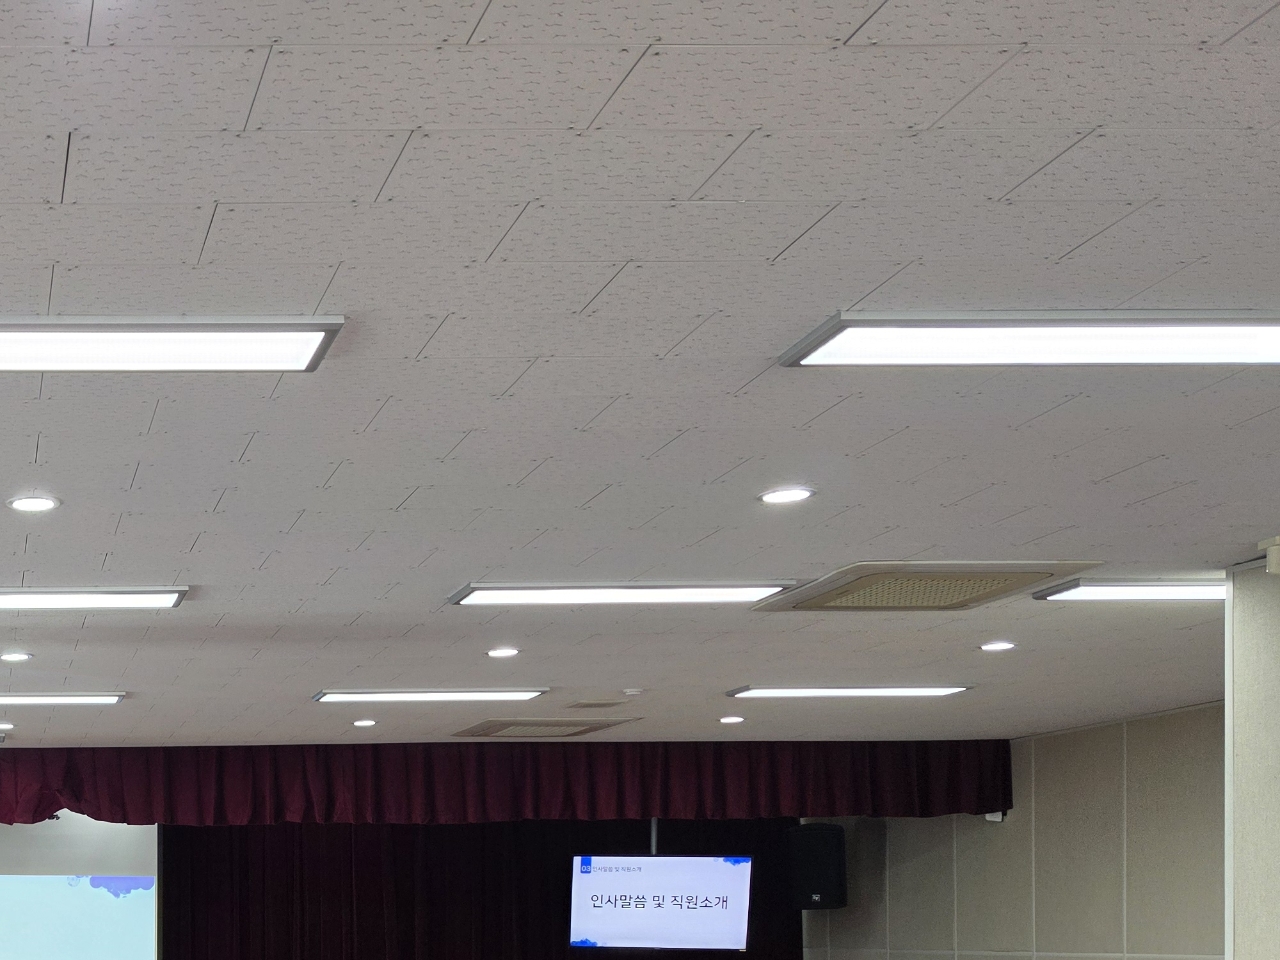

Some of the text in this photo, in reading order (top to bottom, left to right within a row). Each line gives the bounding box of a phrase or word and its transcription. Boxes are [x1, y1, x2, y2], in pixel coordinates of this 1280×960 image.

[590, 894, 728, 910] 인사말씀 및 직원소개
